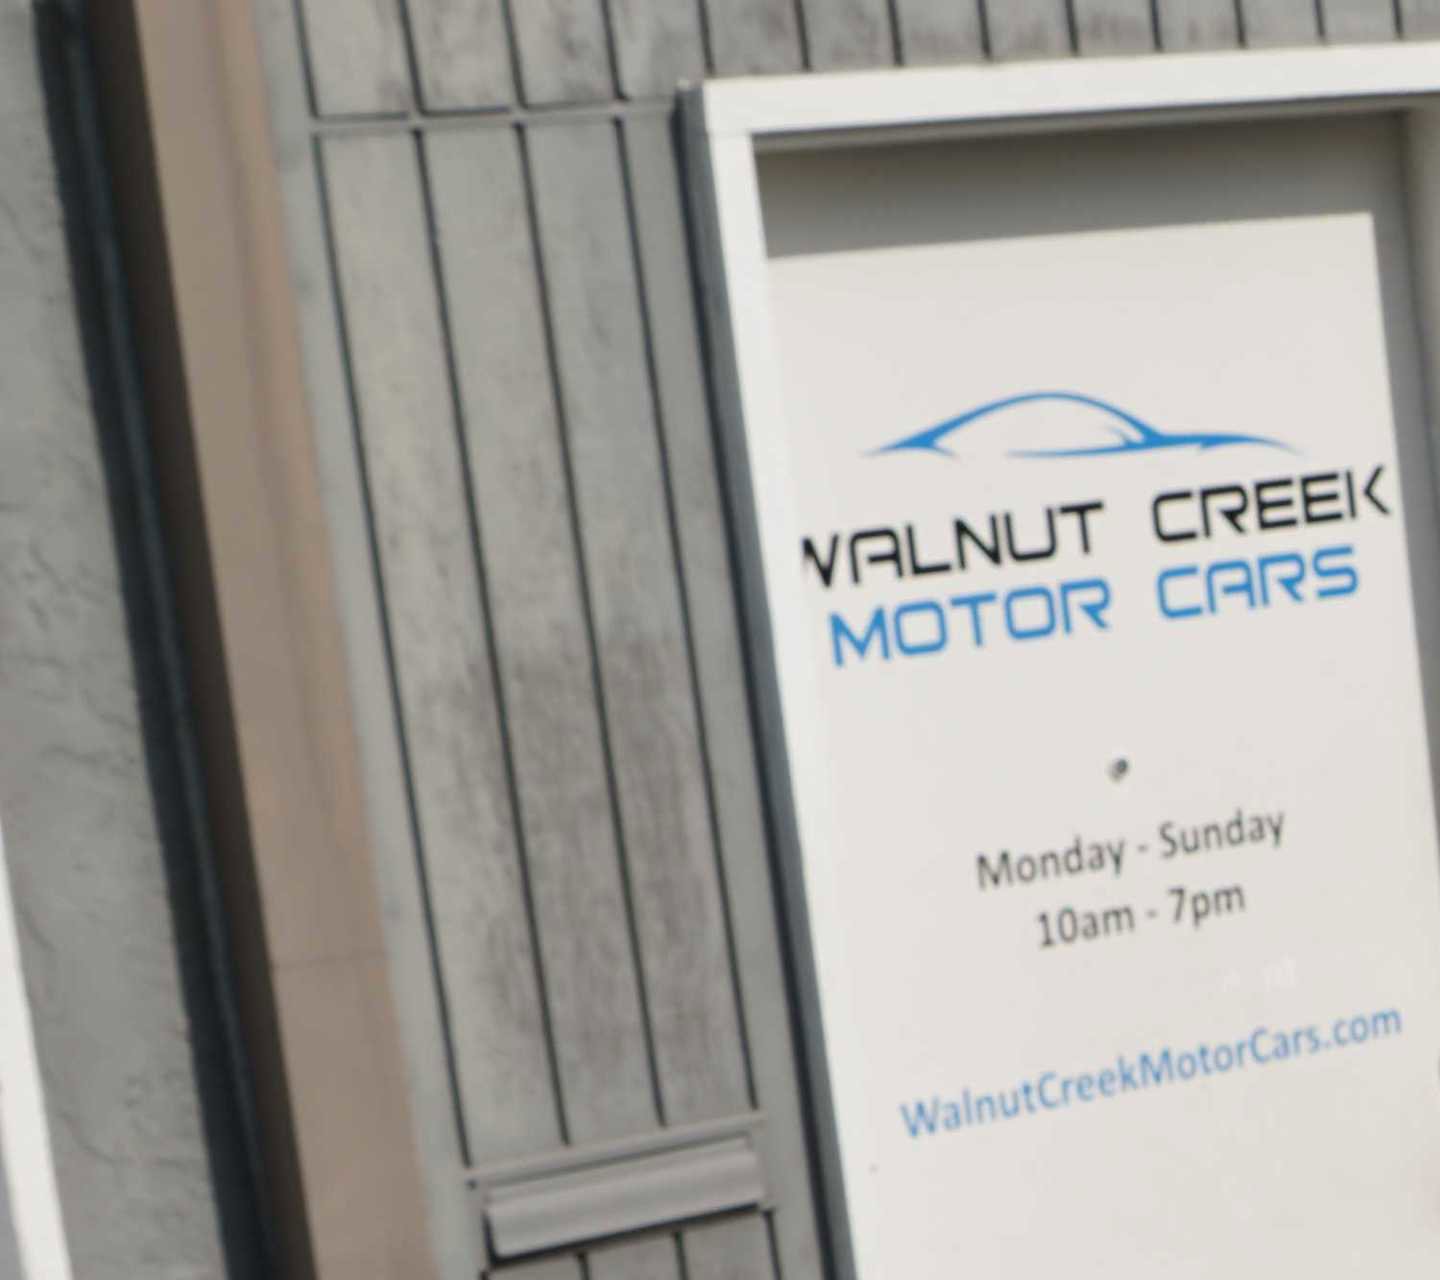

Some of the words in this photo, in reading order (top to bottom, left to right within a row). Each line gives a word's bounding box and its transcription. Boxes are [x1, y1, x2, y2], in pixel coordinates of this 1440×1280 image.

[1152, 463, 1391, 542] CREEK
[829, 577, 1111, 667] MOTOR
[1156, 543, 1360, 619] CARS
[975, 834, 1126, 892] Monday
[1158, 808, 1286, 860] Sunday
[1036, 903, 1136, 951] 10am
[1168, 882, 1247, 929] 7pm
[899, 1006, 1404, 1139] WalnutCreekMotorCars.com
